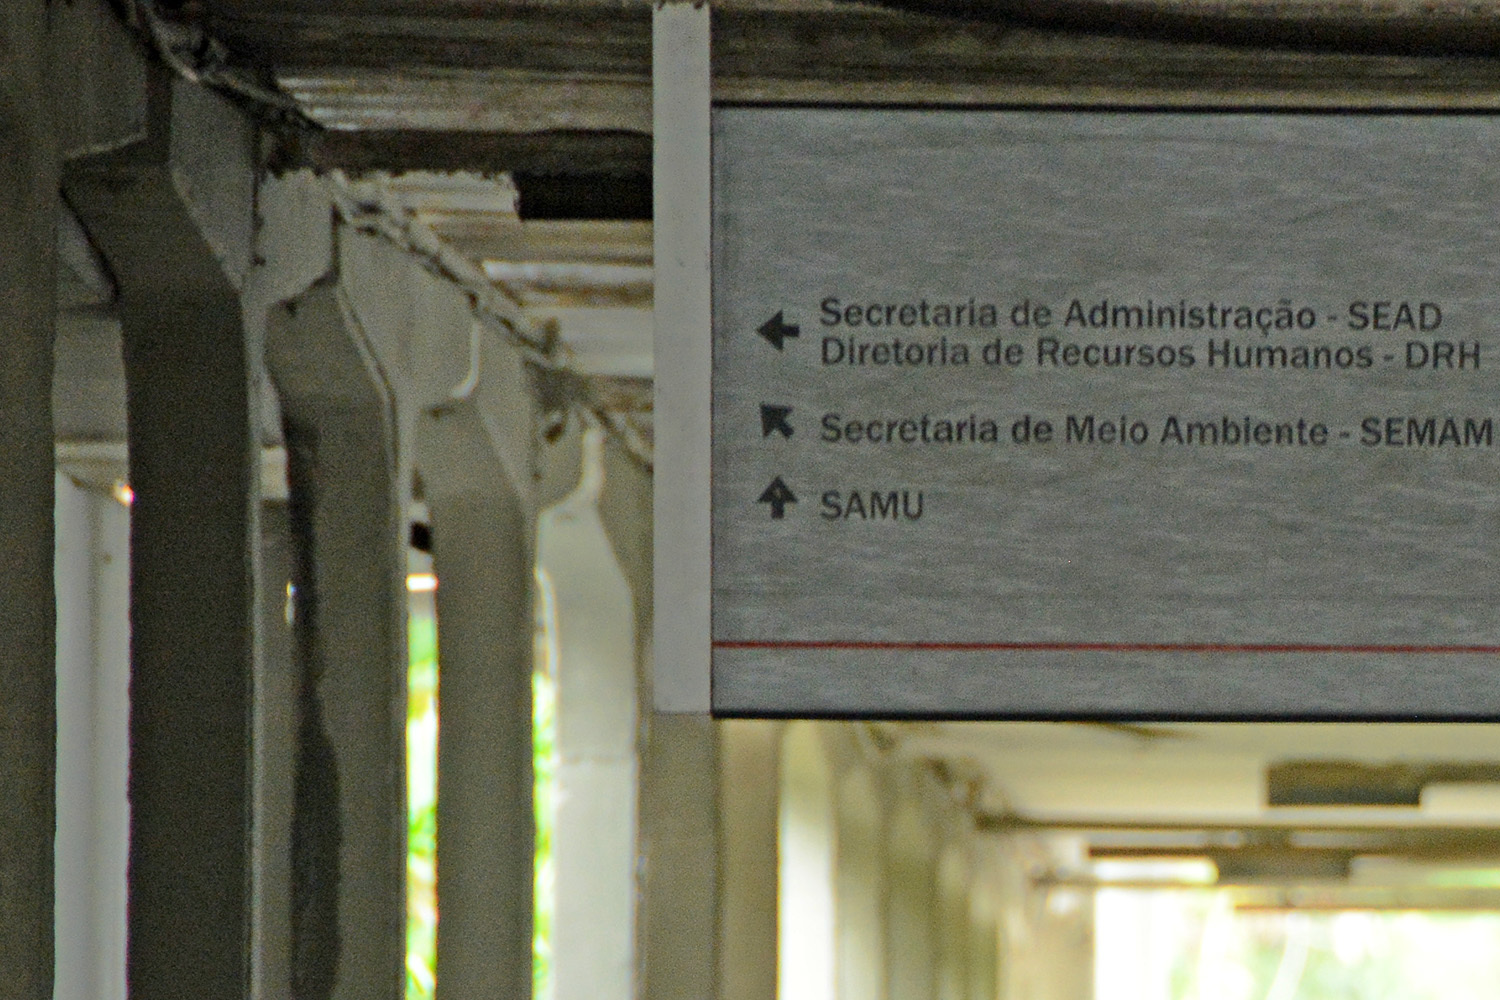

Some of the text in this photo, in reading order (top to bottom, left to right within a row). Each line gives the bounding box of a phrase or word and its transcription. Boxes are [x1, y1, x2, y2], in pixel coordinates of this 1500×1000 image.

[821, 296, 997, 326] Secretaria
[1011, 299, 1051, 327] de
[1065, 299, 1316, 335] Administração
[1349, 301, 1442, 331] SEAD
[822, 337, 969, 365] Diretoria
[983, 339, 1023, 366] de
[1038, 337, 1195, 367] Recursos
[1208, 340, 1373, 368] Humanos
[1406, 342, 1480, 369] DRH
[821, 414, 998, 443] Secretaria
[1011, 415, 1053, 444] de
[1066, 415, 1148, 445] Meio
[1161, 416, 1328, 446] Ambiente
[1361, 417, 1493, 446] SEMAM
[821, 490, 923, 521] SAMU
